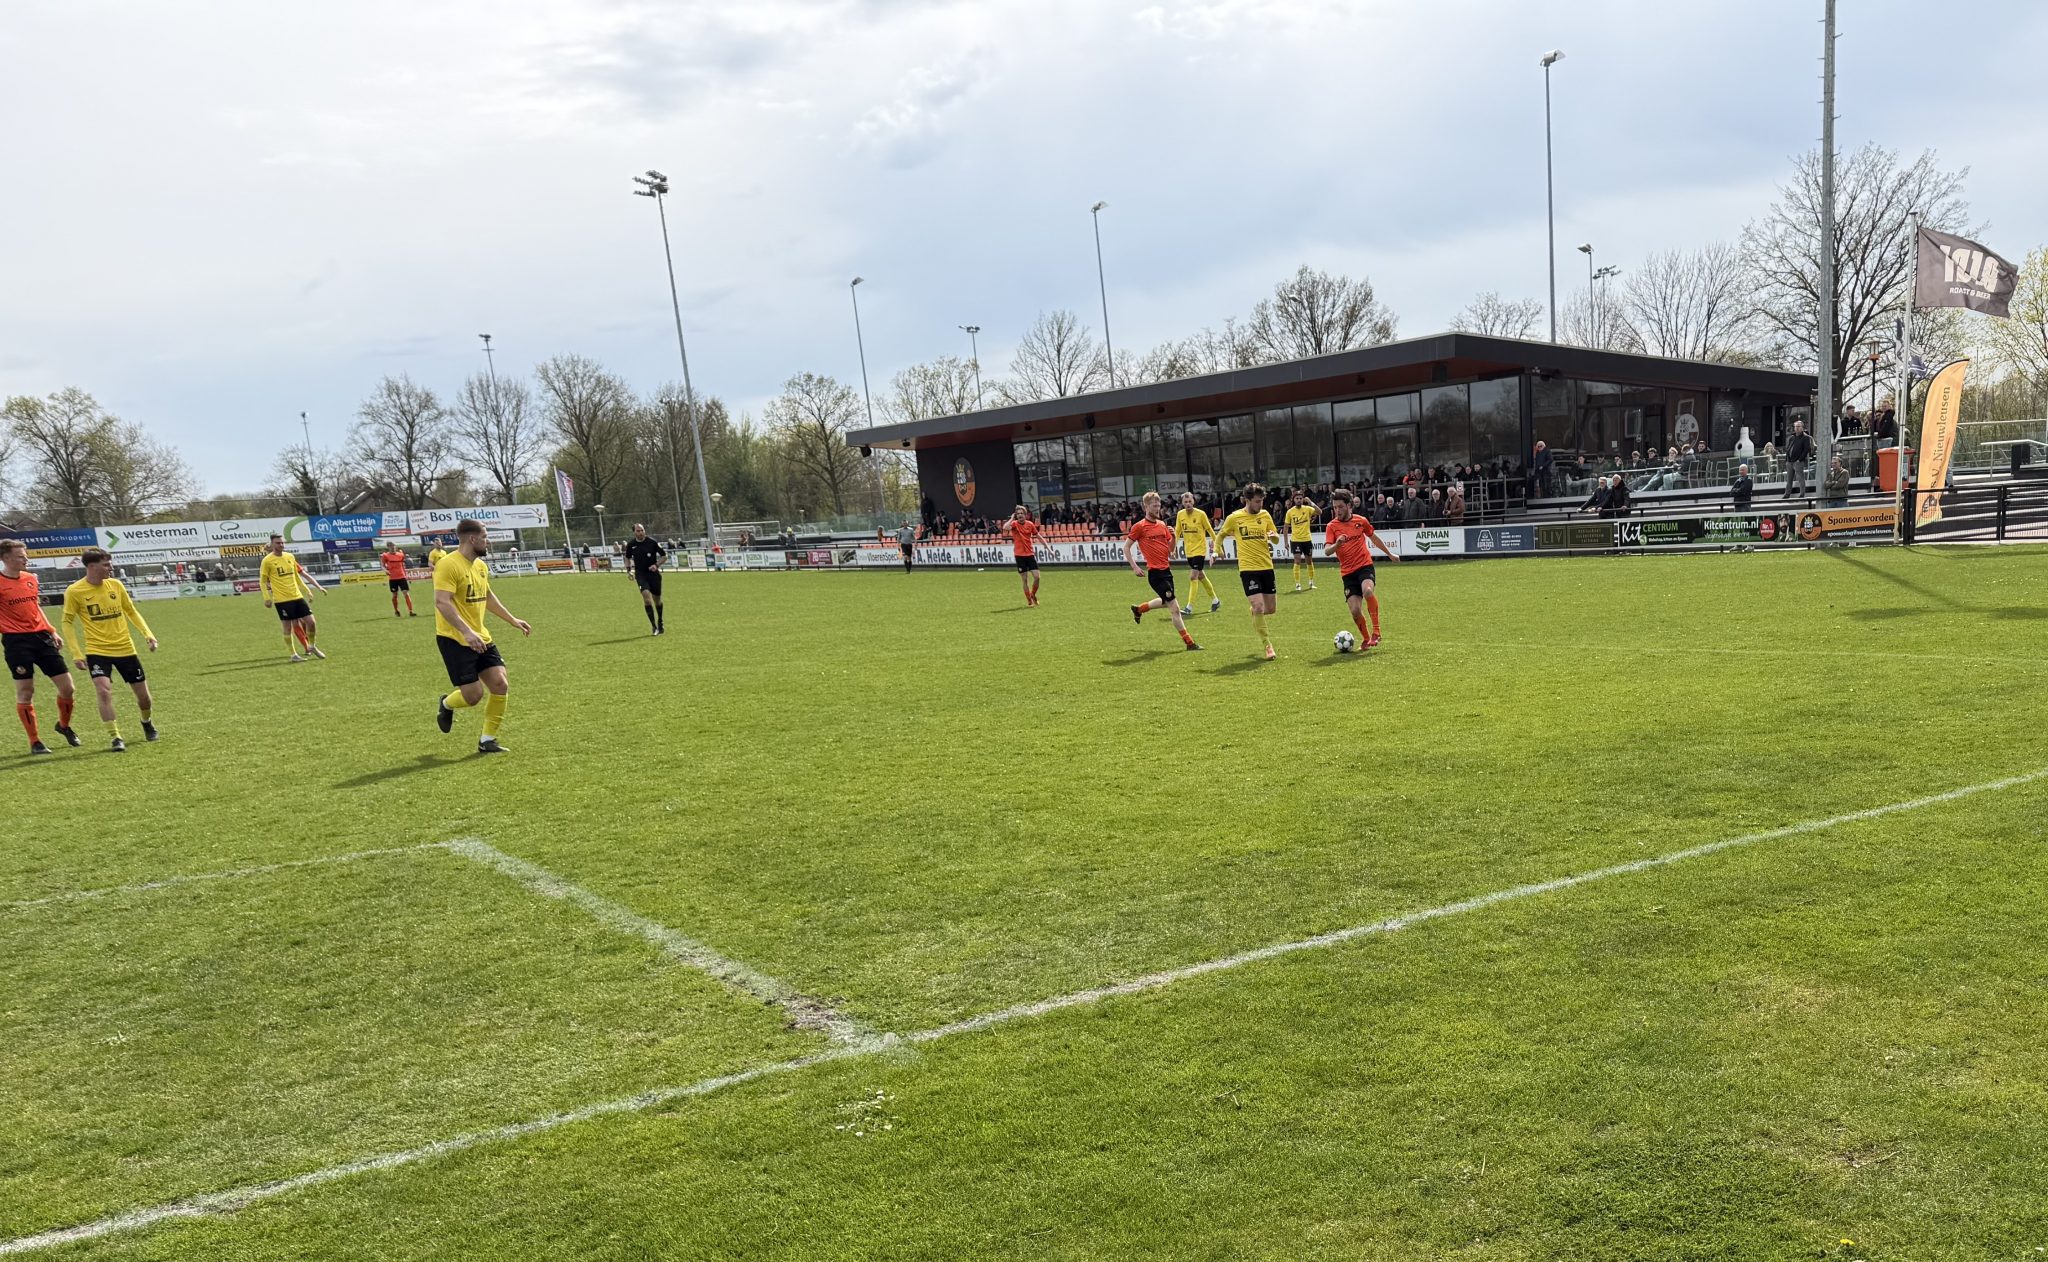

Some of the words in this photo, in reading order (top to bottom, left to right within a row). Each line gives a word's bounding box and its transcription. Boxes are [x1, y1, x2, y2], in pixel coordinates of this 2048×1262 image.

[1933, 386, 1951, 461] Nieuwleusen
[332, 517, 355, 527] Albert
[356, 516, 376, 527] Heijn
[429, 511, 452, 523] Bos
[454, 508, 500, 521] Bedden
[1827, 515, 1862, 526] Sponsor
[1863, 512, 1894, 522] worden
[337, 525, 352, 534] Van
[353, 523, 373, 533] Etten
[1703, 518, 1759, 531] Kitcentrum.nl
[50, 533, 92, 543] Schippers
[123, 526, 198, 540] westerman
[1415, 530, 1450, 540] ARFMAN
[1542, 530, 1563, 544] LIV
[1622, 522, 1642, 543] Kit
[1643, 522, 1679, 533] CENTRUM
[170, 548, 216, 559] Medigros
[926, 547, 952, 563] Heide
[976, 545, 1004, 562] Heide
[1091, 543, 1124, 560] Heide
